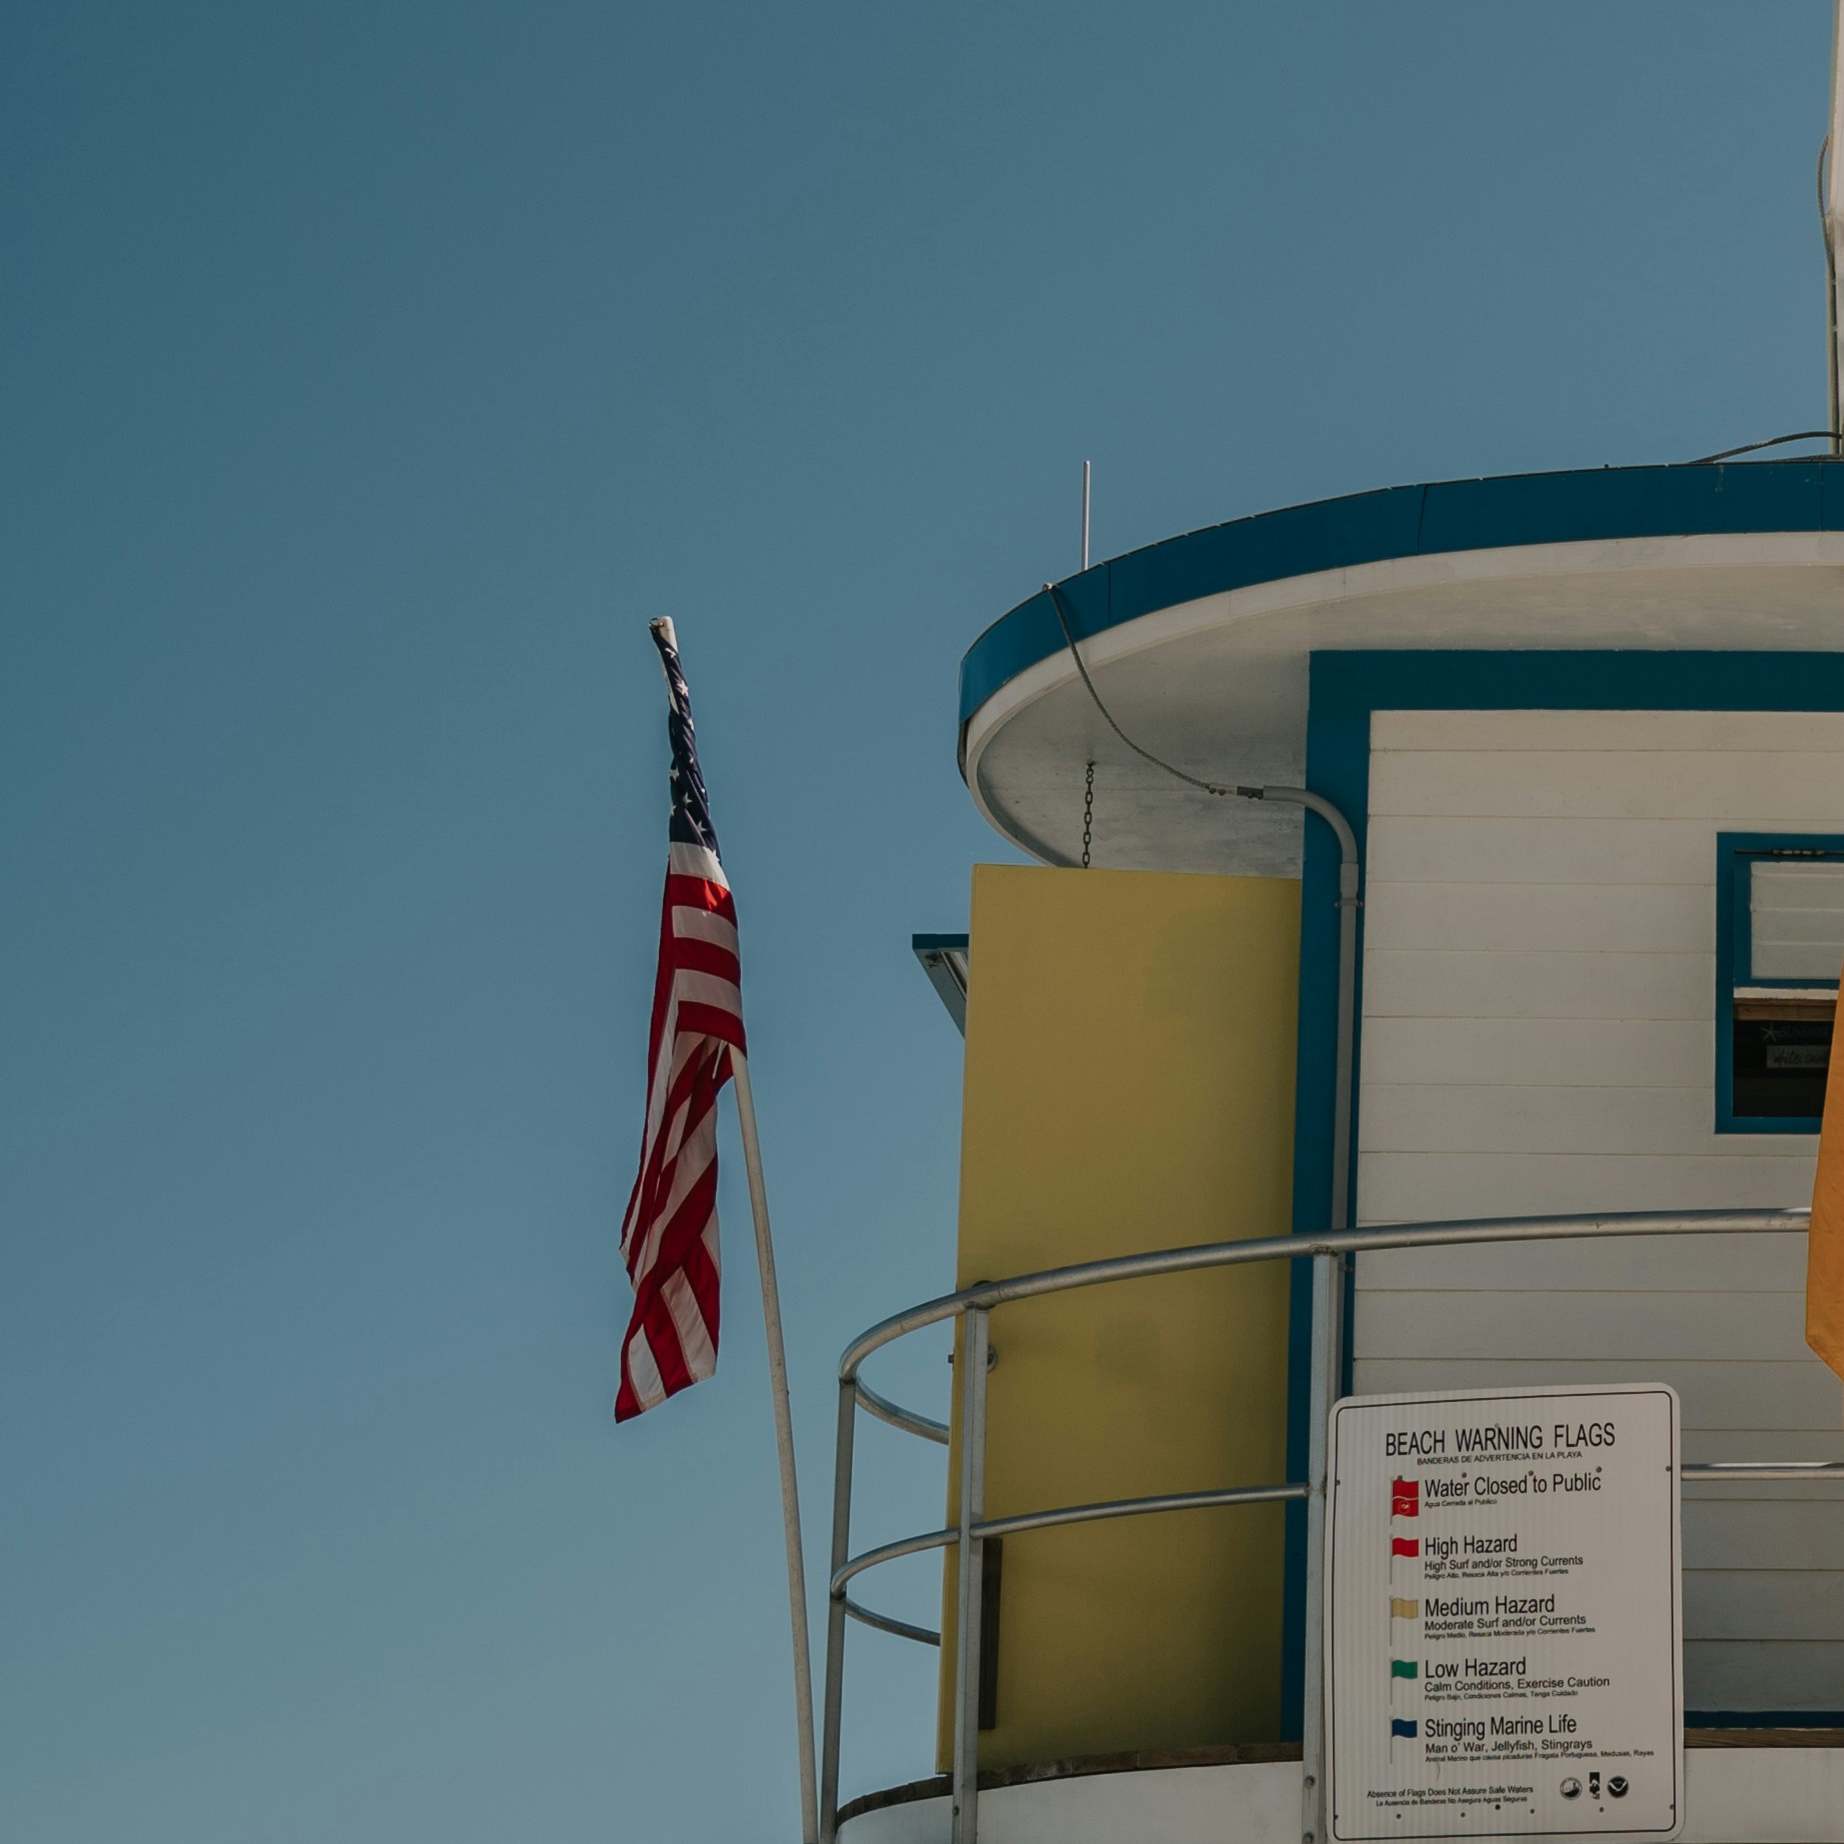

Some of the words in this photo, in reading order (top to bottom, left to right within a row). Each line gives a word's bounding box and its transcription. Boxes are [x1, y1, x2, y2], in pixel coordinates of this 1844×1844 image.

[1386, 1430, 1445, 1456] BEACH
[1455, 1425, 1543, 1452] WARNING
[1555, 1422, 1615, 1448] FLAGS
[1417, 1456, 1459, 1465] BANDERAS
[1474, 1453, 1531, 1462] ADVERTENCIA
[1557, 1451, 1582, 1459] PLAYA
[1425, 1478, 1469, 1498] Water
[1474, 1475, 1527, 1495] Closed
[1532, 1476, 1547, 1493] to
[1553, 1472, 1601, 1493] Public
[1425, 1536, 1458, 1560] High
[1464, 1533, 1517, 1555] Hazard
[1424, 1560, 1446, 1573] High
[1449, 1559, 1470, 1570] Surf
[1472, 1557, 1502, 1570] and/or
[1505, 1556, 1538, 1569] Strong
[1540, 1555, 1584, 1566] Currents
[1425, 1597, 1489, 1617] Medium
[1495, 1593, 1554, 1615] Hazard
[1424, 1619, 1474, 1631] Moderate
[1477, 1617, 1499, 1629] Surf
[1502, 1616, 1536, 1628] and/or
[1539, 1615, 1587, 1626] Currents
[1425, 1659, 1459, 1679] Low
[1465, 1656, 1526, 1677] Hazard
[1424, 1681, 1451, 1693] Calm
[1454, 1679, 1514, 1692] Conditions,
[1517, 1677, 1564, 1689] Exercise
[1567, 1676, 1610, 1687] Caution
[1425, 1718, 1485, 1742] Stinging
[1490, 1716, 1543, 1736] Marine
[1548, 1714, 1577, 1733] Life
[1425, 1743, 1448, 1754] Man
[1463, 1742, 1488, 1753] War,
[1491, 1740, 1537, 1753] Jellyfish,
[1541, 1739, 1593, 1751] Stingrays
[1367, 1790, 1397, 1798] Absence
[1399, 1789, 1405, 1797] of
[1407, 1788, 1426, 1797] Flags
[1428, 1788, 1446, 1796] Does
[1448, 1787, 1461, 1796] Not
[1462, 1787, 1487, 1795] Assure
[1489, 1786, 1506, 1795] Safe
[1507, 1785, 1533, 1794] Waters
